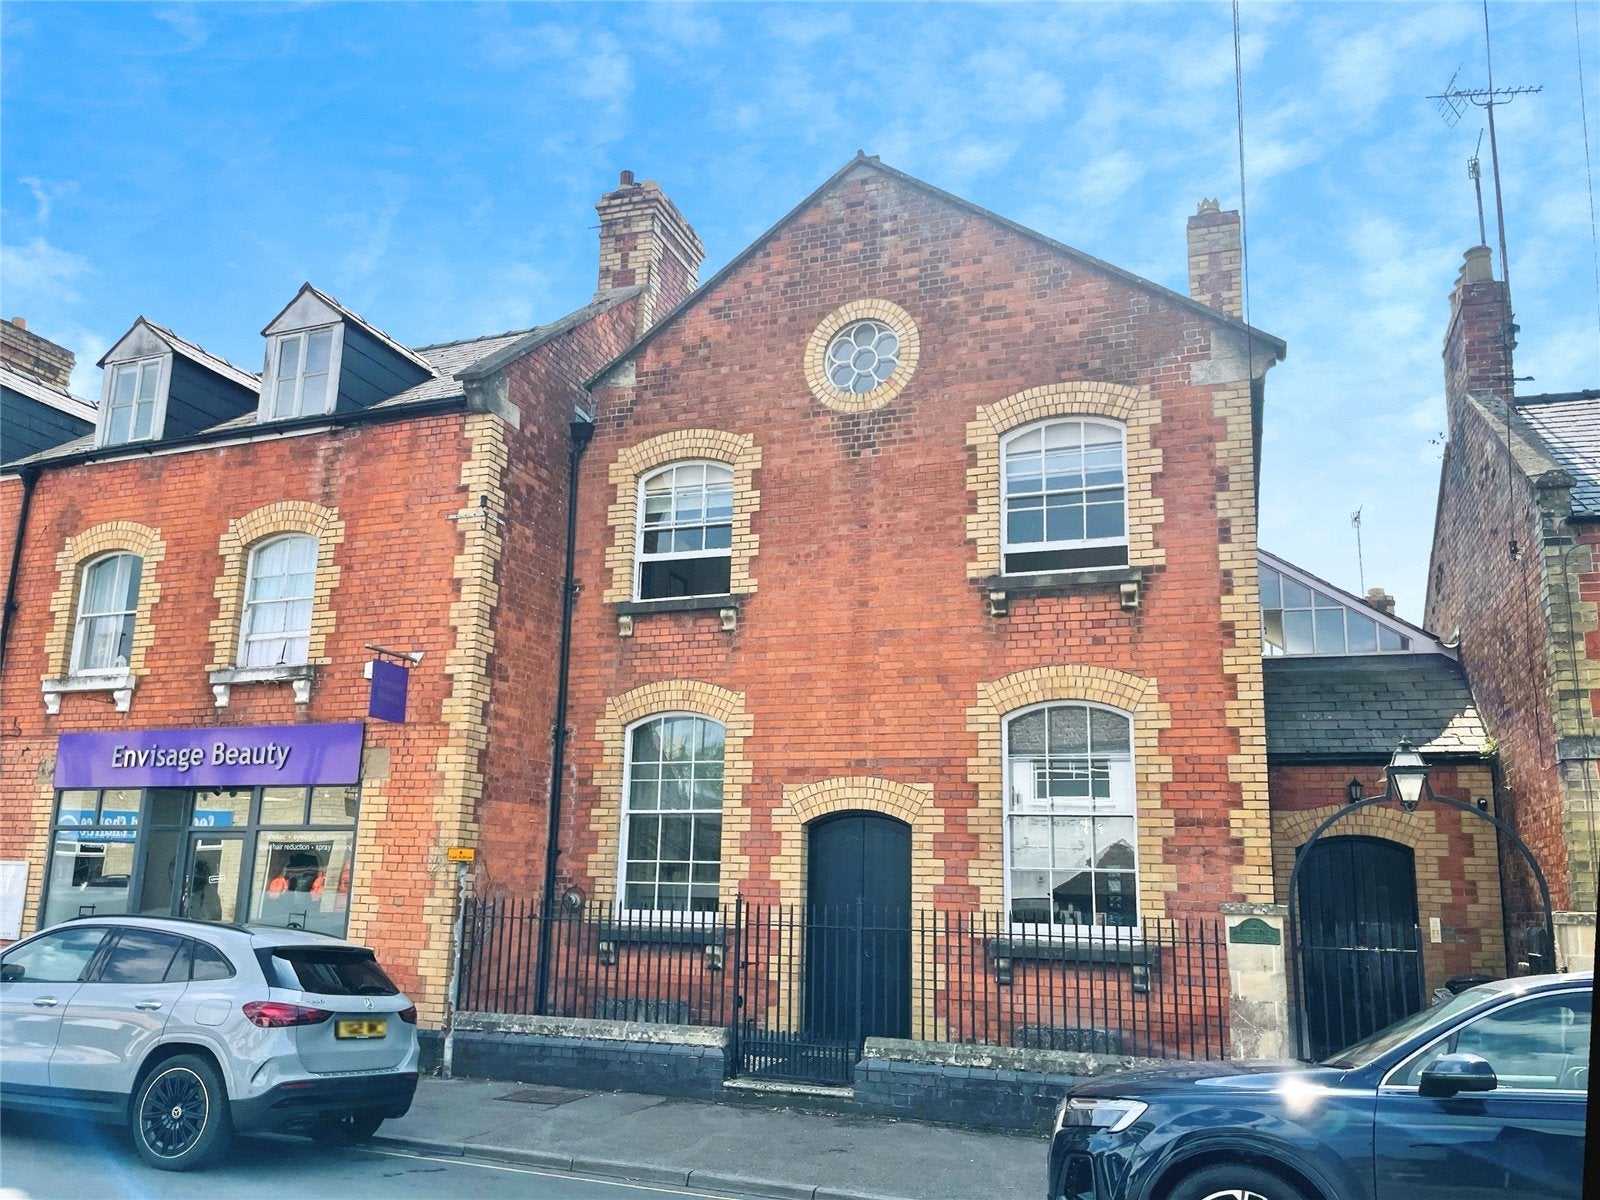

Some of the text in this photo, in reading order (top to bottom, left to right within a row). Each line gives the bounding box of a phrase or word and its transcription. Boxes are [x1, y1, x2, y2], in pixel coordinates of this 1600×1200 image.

[112, 742, 291, 772] Envisage Beauty
[272, 843, 283, 851] hair
[284, 843, 310, 851] reduction
[315, 844, 331, 852] spray
